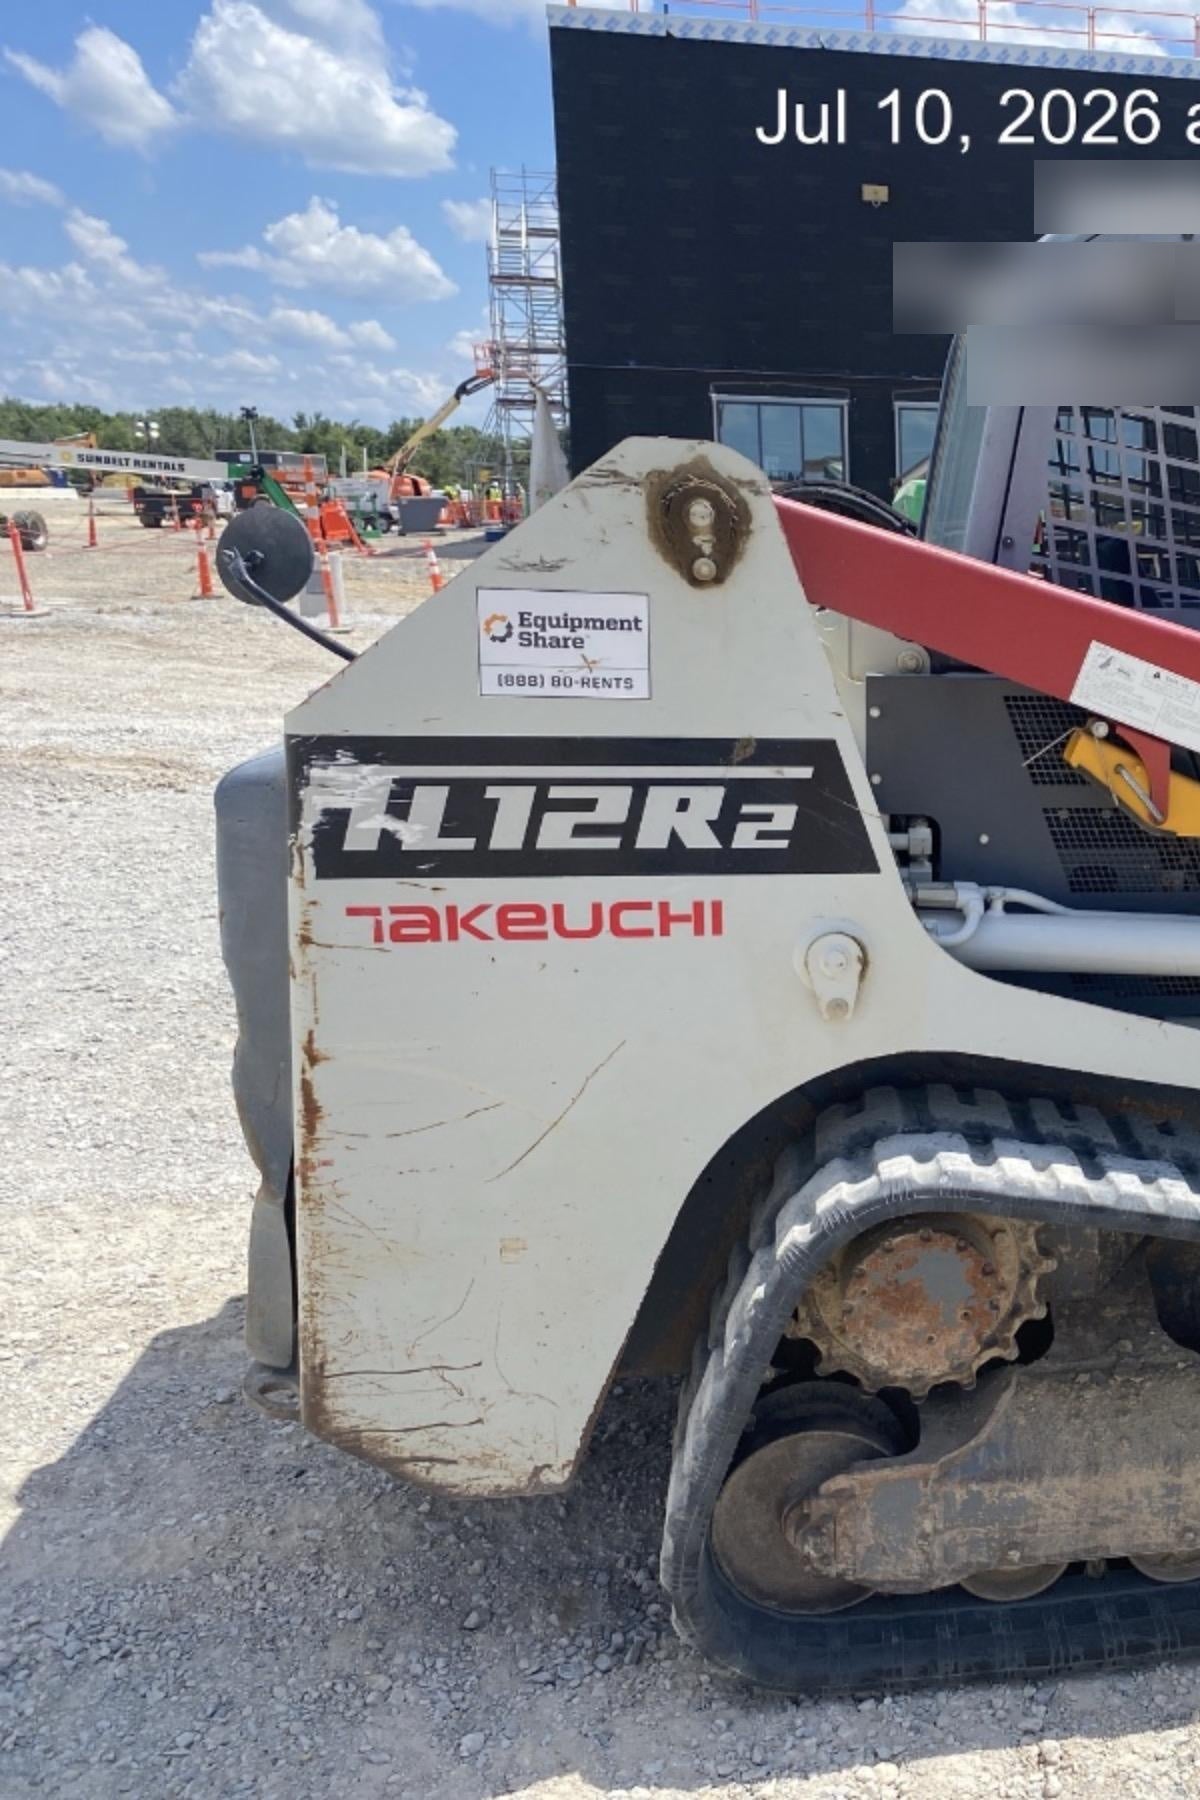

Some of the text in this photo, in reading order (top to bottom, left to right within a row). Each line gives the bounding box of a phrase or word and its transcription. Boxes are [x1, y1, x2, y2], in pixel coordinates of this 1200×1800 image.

[77, 453, 186, 472] SUNBELT RENTALS
[518, 611, 643, 633] Equipment
[518, 631, 585, 649] Share
[497, 674, 634, 690] (888) 80-RENTS
